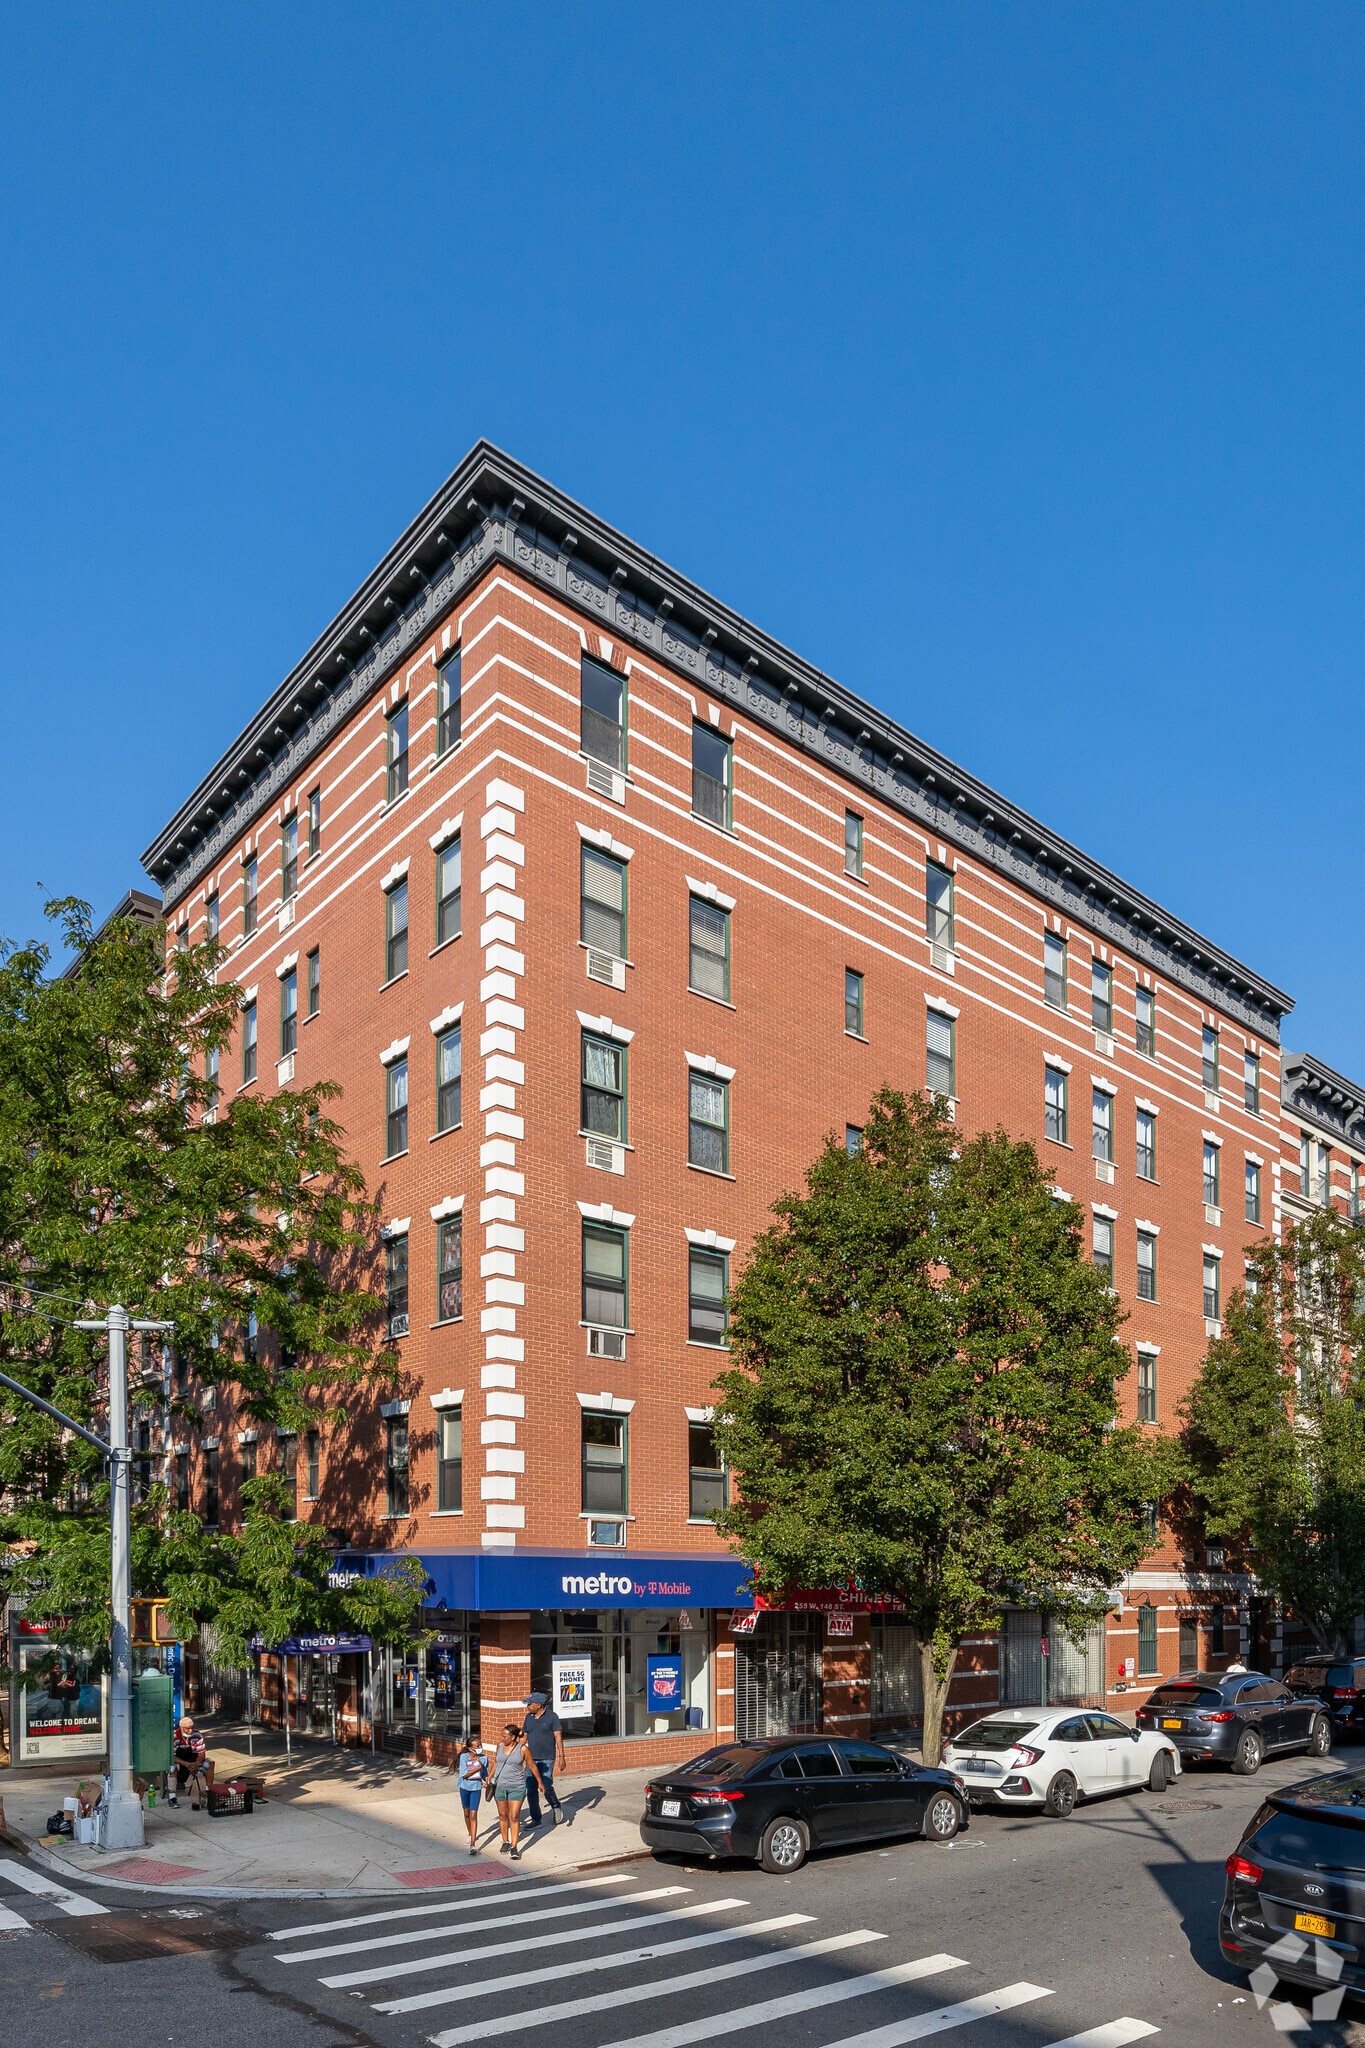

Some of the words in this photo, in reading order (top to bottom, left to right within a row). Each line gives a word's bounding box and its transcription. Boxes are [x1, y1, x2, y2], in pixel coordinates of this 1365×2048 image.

[562, 1572, 632, 1594] metro
[633, 1582, 646, 1597] by
[731, 1616, 755, 1628] ATM
[829, 1620, 851, 1631] ATM
[301, 1636, 336, 1647] metro
[29, 1719, 62, 1728] WELCOME
[63, 1718, 73, 1726] TO
[74, 1717, 99, 1726] DREAM.
[29, 1727, 62, 1736] WELCOME
[1306, 1886, 1320, 1894] KIA
